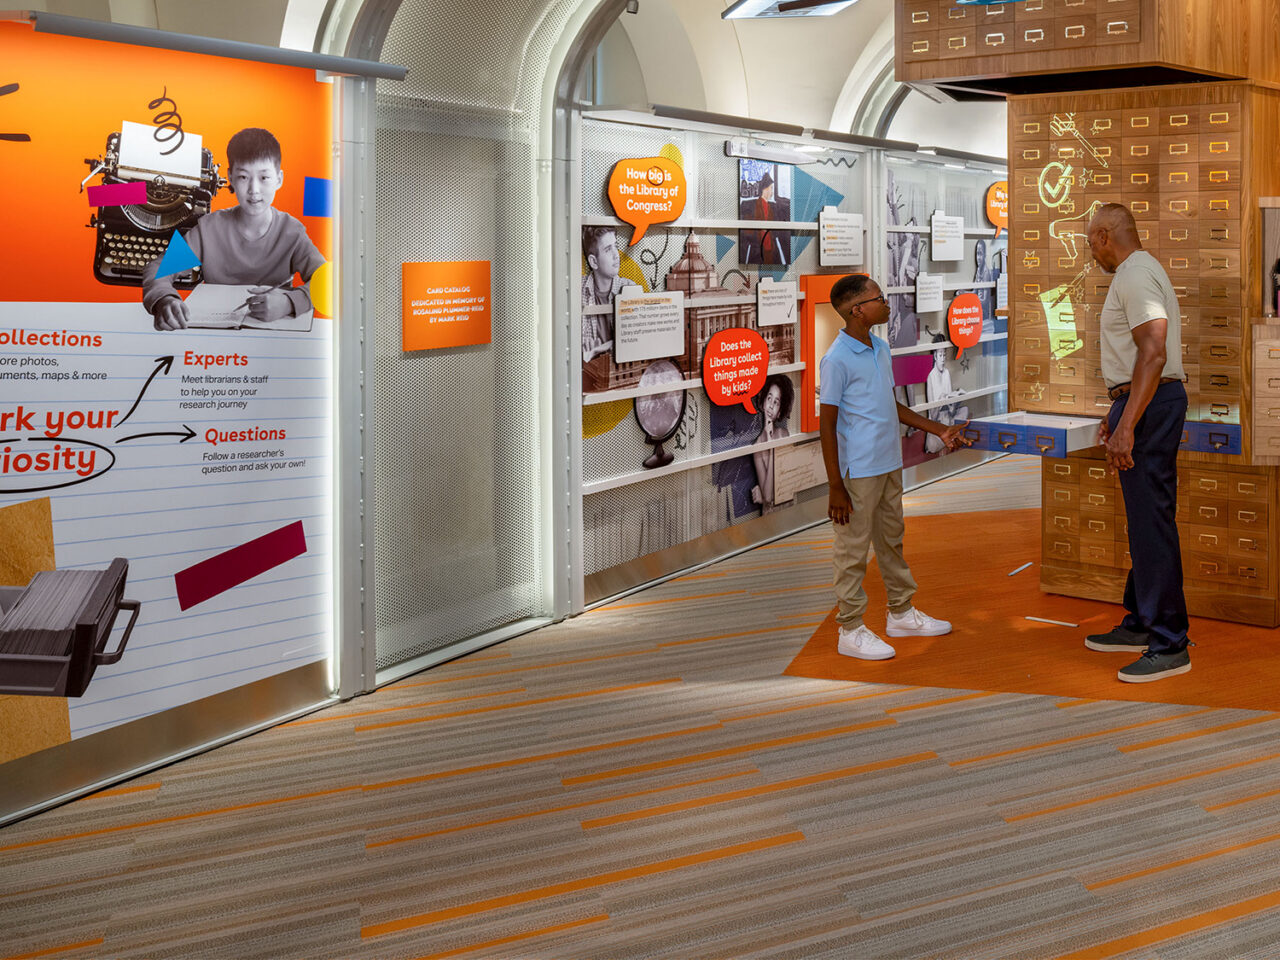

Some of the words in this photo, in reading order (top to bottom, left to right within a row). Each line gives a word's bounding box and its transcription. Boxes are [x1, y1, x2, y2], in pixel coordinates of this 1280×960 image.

[626, 167, 648, 179] How
[648, 166, 663, 184] big
[664, 168, 672, 180] is
[618, 184, 635, 195] the
[636, 184, 669, 197] Library
[669, 184, 679, 196] of
[626, 198, 673, 214] Congress?
[427, 287, 444, 295] CARD
[444, 286, 471, 294] CATALOG
[411, 299, 444, 307] DEDICATED
[452, 297, 477, 305] MEMORY
[413, 307, 443, 316] ROSALIND
[443, 305, 484, 314] PLUMMER-REID
[953, 307, 962, 315] How
[962, 306, 972, 314] does
[438, 315, 456, 323] MARK
[456, 314, 469, 322] REID
[951, 317, 966, 326] Library
[720, 341, 738, 352] Does
[739, 339, 752, 350] the
[20, 356, 59, 367] photos,
[184, 350, 248, 370] Experts
[709, 356, 737, 368] Library
[737, 351, 762, 364] collect
[41, 371, 70, 381] maps
[72, 371, 79, 380] &
[82, 372, 107, 380] more
[181, 375, 203, 384] Meet
[205, 375, 241, 384] librarians
[243, 375, 249, 384] &
[250, 375, 269, 383] staff
[714, 370, 737, 382] things
[738, 366, 759, 377] made
[180, 388, 189, 396] to
[191, 388, 209, 398] help
[211, 389, 226, 399] you
[240, 389, 257, 398] your
[721, 384, 732, 397] by
[732, 380, 752, 394] kids?
[179, 401, 216, 409] research
[216, 400, 248, 410] journey
[44, 410, 119, 438] your
[205, 426, 286, 446] Questions
[0, 444, 96, 477] iosity
[203, 452, 228, 461] Follow
[237, 449, 285, 459] researcher's
[201, 463, 237, 475] question
[239, 462, 254, 471] and
[255, 461, 268, 470] ask
[270, 461, 287, 471] your
[288, 459, 306, 468] own!
